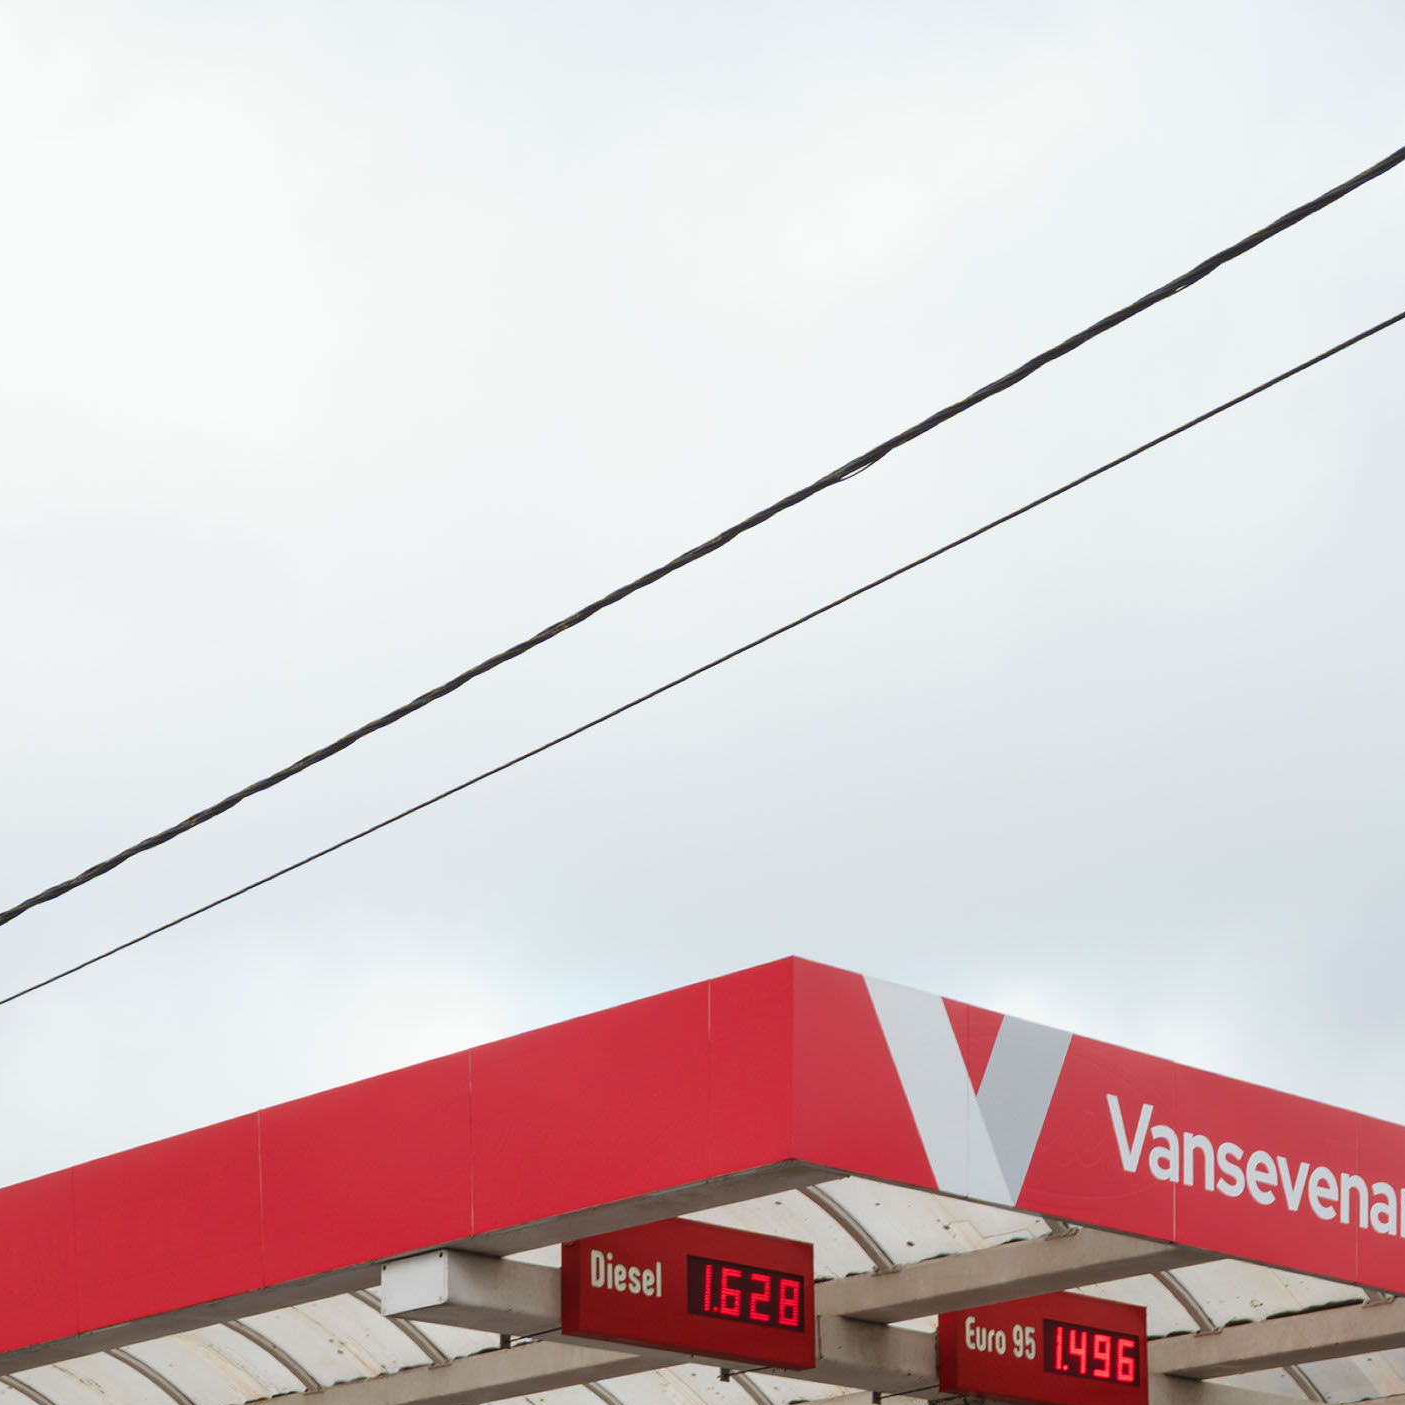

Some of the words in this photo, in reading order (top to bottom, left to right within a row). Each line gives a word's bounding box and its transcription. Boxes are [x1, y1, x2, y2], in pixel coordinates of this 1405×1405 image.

[590, 1249, 662, 1299] Diesel
[703, 1263, 801, 1328] 1.628
[965, 1316, 1007, 1356] Euro
[1012, 1329, 1037, 1361] 95
[1054, 1326, 1136, 1384] 1.496
